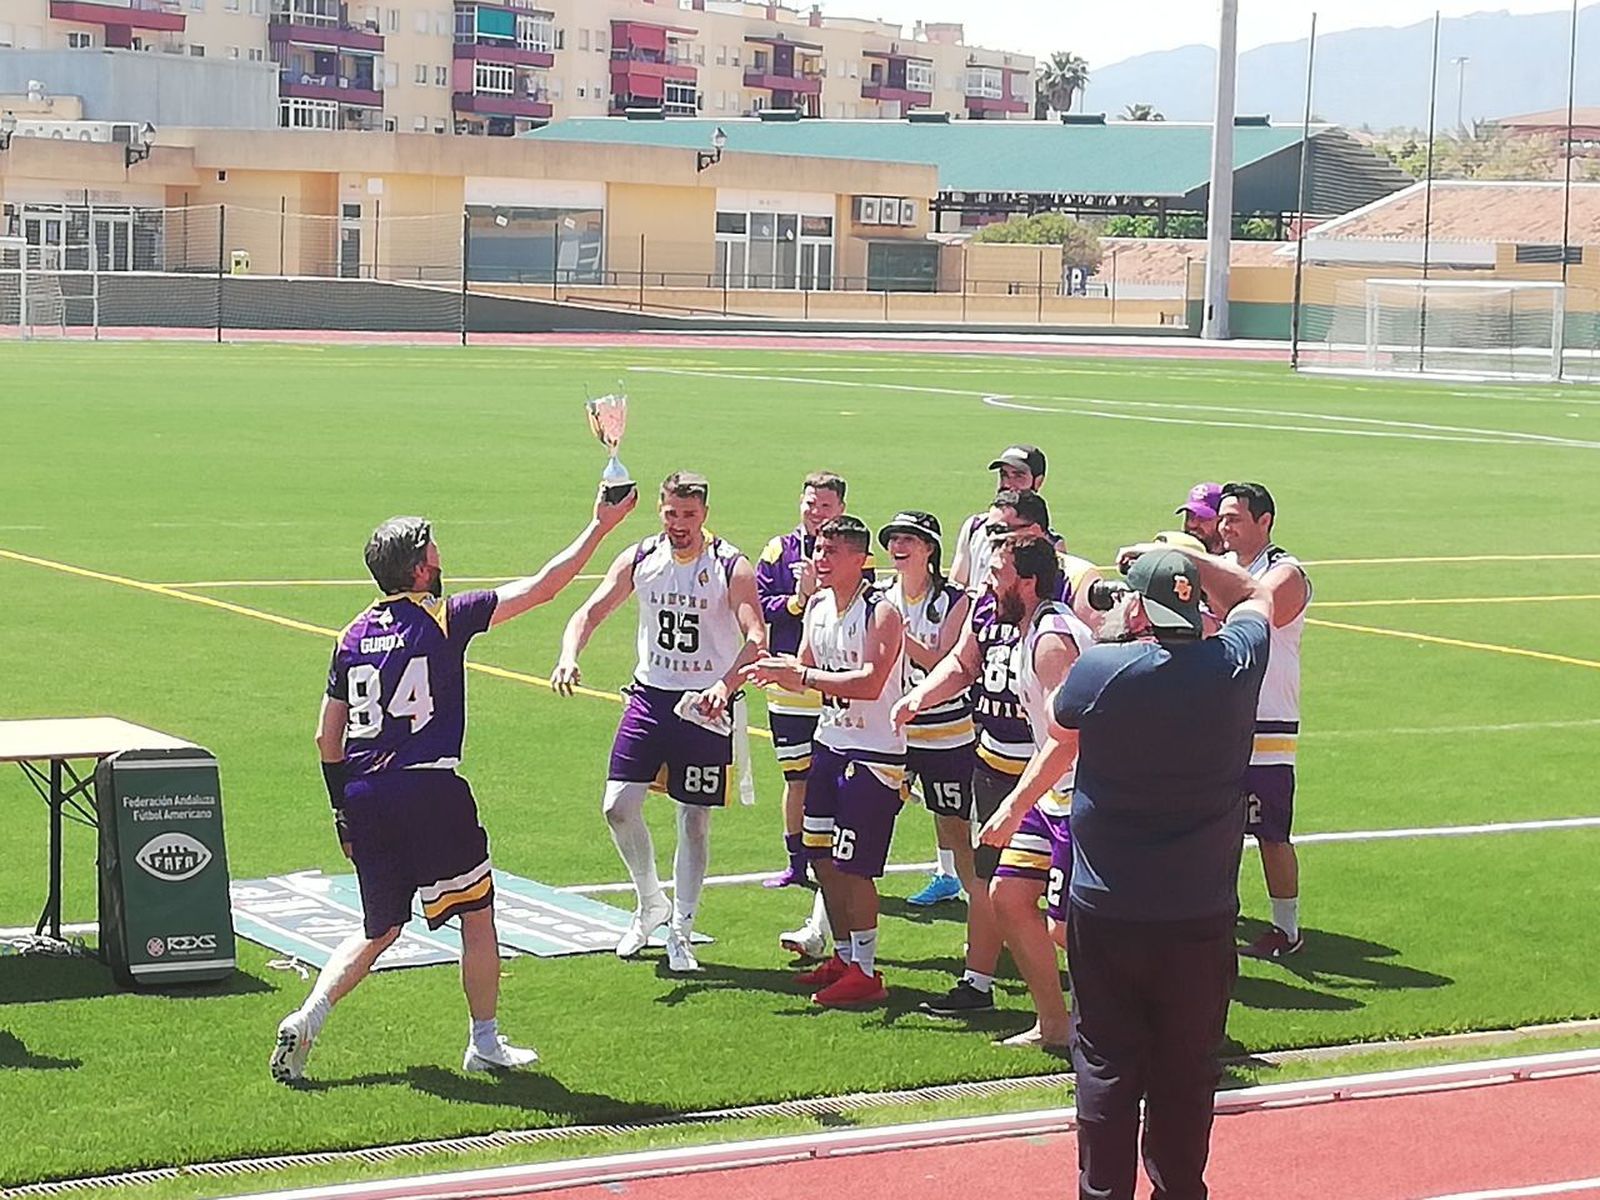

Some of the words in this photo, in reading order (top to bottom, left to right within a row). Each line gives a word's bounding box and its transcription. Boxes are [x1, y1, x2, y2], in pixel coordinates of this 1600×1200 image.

[657, 609, 700, 653] 85
[346, 656, 435, 739] 84
[684, 765, 720, 794] 85
[122, 795, 173, 808] Federación
[933, 782, 962, 810] 15
[164, 809, 212, 820] Americano
[153, 854, 194, 871] FAFA
